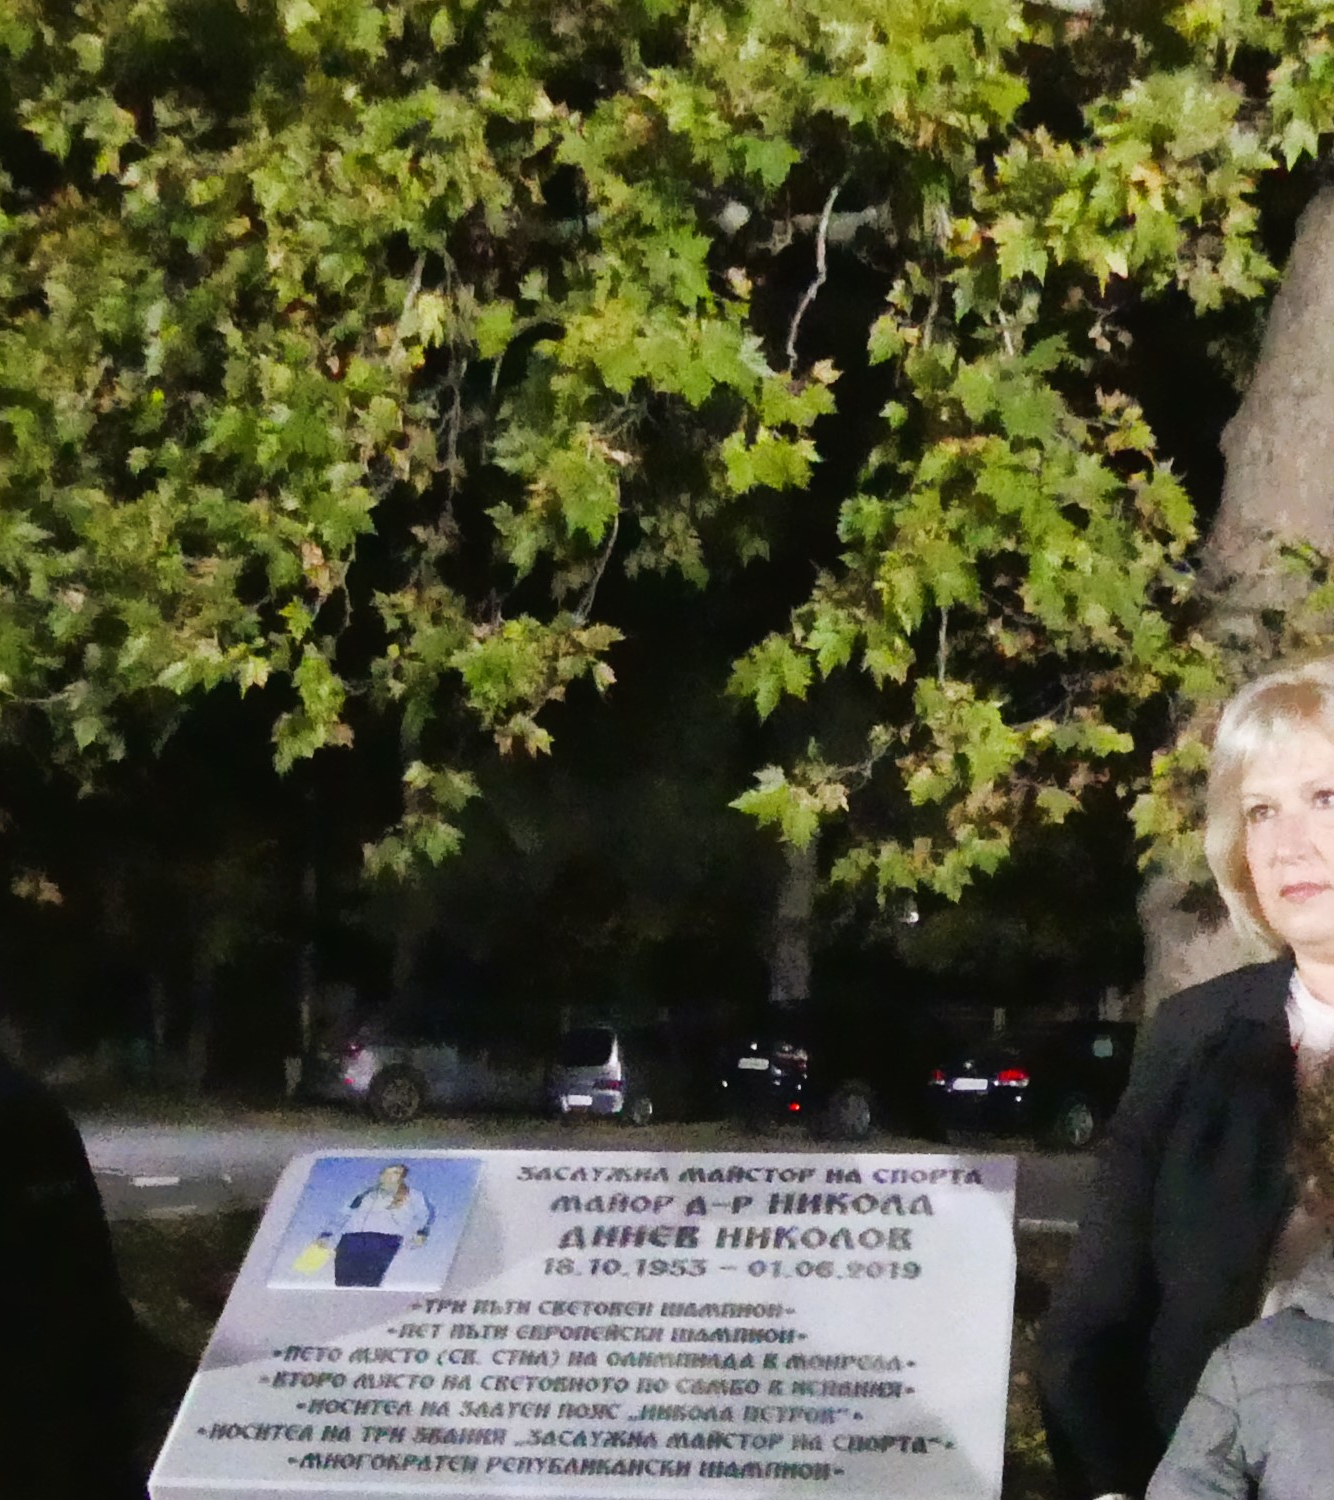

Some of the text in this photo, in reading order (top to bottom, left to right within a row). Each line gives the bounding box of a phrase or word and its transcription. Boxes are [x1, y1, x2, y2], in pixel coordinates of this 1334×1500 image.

[678, 1165, 816, 1183] МАЙСТОР
[825, 1168, 862, 1184] НА
[872, 1168, 982, 1185] СПОРТА
[550, 1192, 674, 1214] МАЙОР
[768, 1192, 934, 1216] НИКОЛА
[715, 1226, 913, 1250] НИКОЛОВ
[543, 1257, 708, 1277] 18.10.1953
[748, 1259, 921, 1279] 01.06.2019
[568, 1351, 598, 1366] НА
[441, 1374, 472, 1390] НА
[636, 1377, 668, 1393] ПО
[420, 1401, 450, 1417] НА
[321, 1425, 351, 1442] НА
[362, 1426, 406, 1443] ТРИ
[792, 1433, 822, 1451] НА
